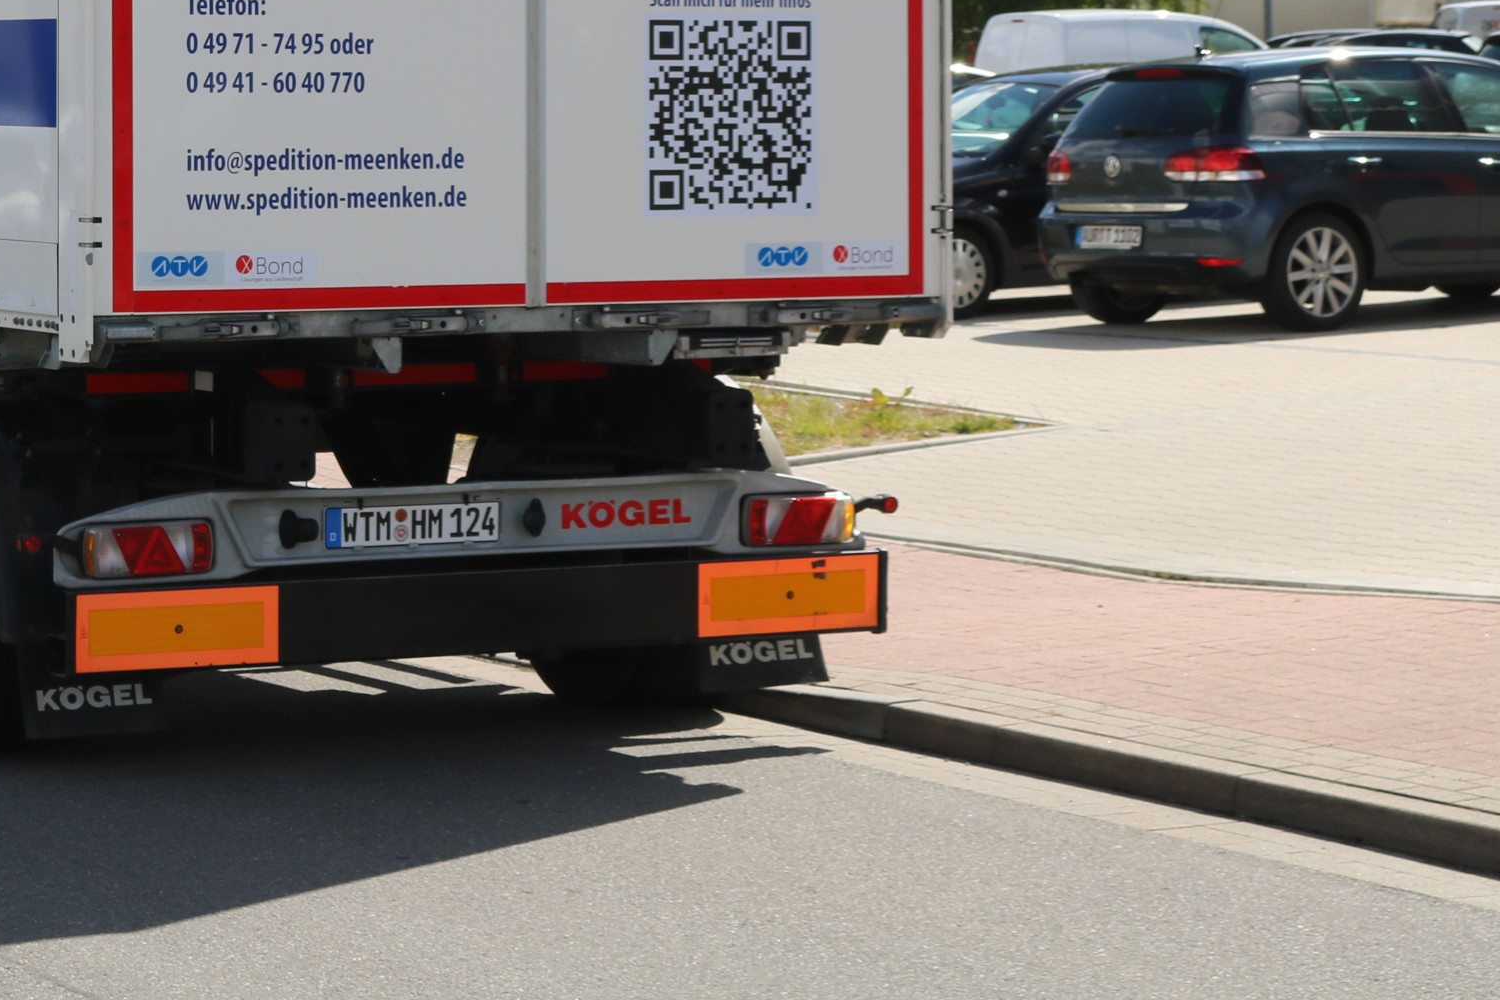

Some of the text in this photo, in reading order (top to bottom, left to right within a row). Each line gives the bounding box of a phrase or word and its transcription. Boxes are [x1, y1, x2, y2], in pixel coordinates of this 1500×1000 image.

[186, 33, 374, 55] 0 49 71 74 95 oder
[186, 71, 365, 93] 0 49 41 60 40 770
[186, 147, 464, 176] info@spedition-meenken.de
[186, 185, 467, 216] www.spedition-meenken.de
[343, 511, 390, 542] WTM
[411, 509, 442, 539] HM
[450, 507, 495, 538] 124
[561, 499, 691, 530] KÖGEL
[709, 638, 814, 667] KÖGEL
[35, 682, 152, 712] KÖGEL
